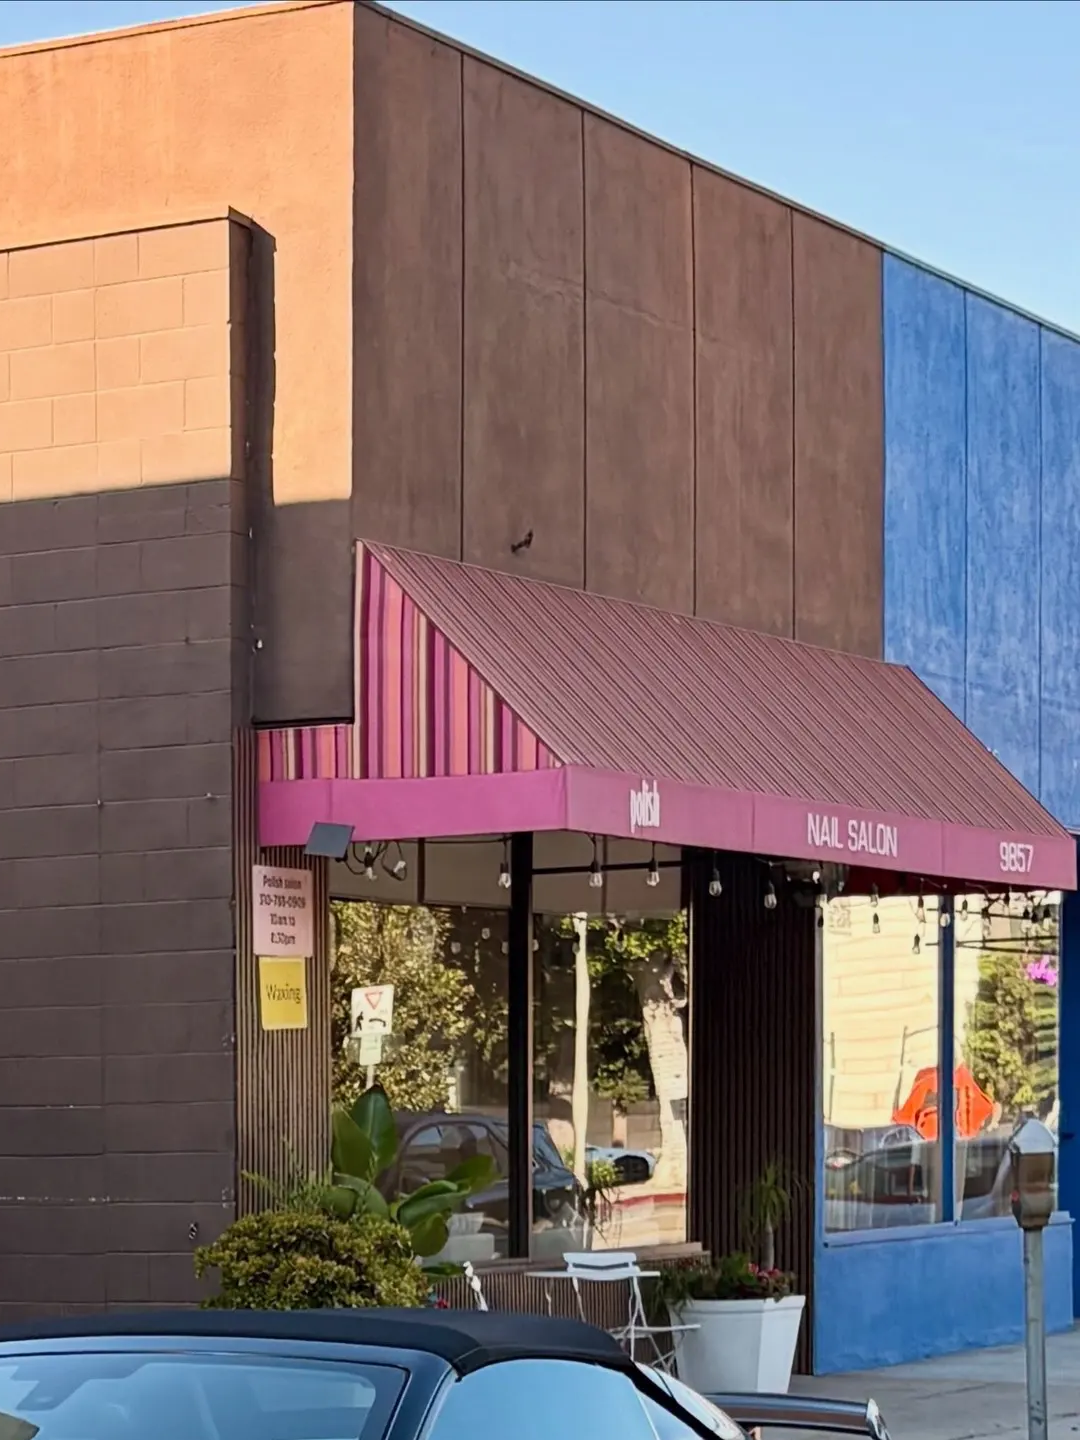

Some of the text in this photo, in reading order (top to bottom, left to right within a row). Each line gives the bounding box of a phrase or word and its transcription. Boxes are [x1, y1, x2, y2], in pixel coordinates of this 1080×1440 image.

[807, 812, 898, 858] NAIL SALON
[999, 841, 1034, 873] 9857
[266, 983, 301, 1005] Waxing
